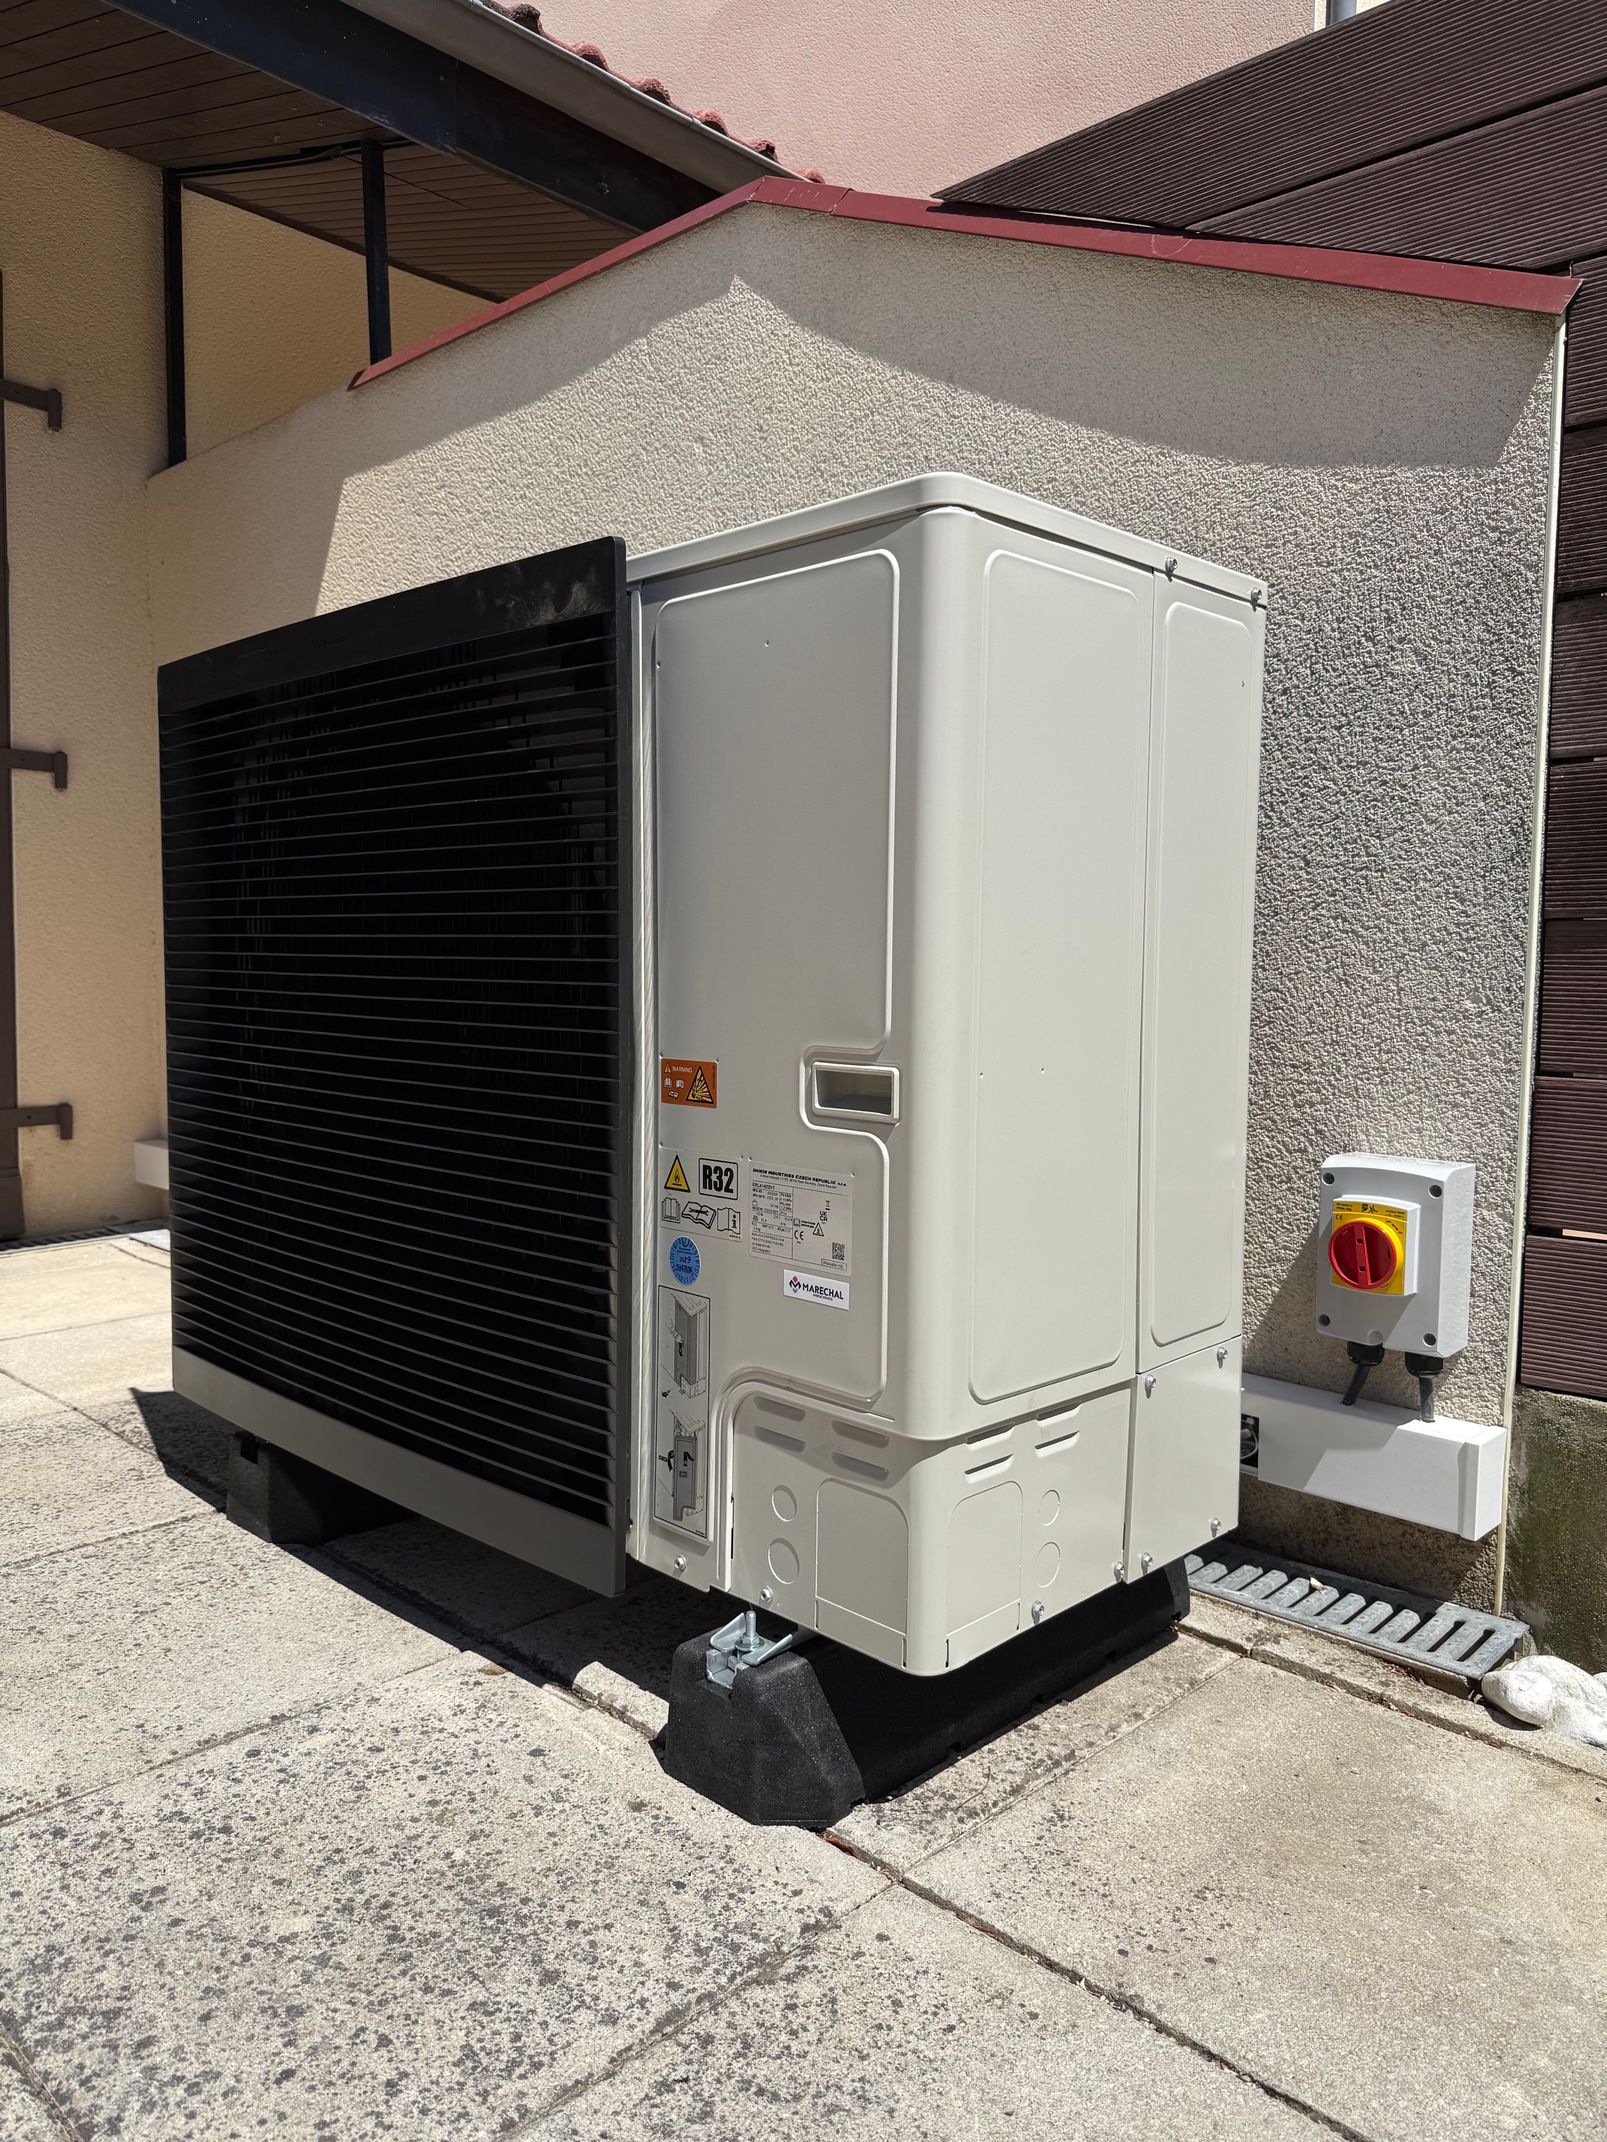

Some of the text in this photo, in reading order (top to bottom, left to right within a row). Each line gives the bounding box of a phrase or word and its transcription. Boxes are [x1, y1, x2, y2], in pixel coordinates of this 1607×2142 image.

[702, 1164, 735, 1194] R32
[768, 1170, 795, 1178] INDUSTRIES
[812, 1177, 837, 1185] REPUBLIC
[802, 1283, 844, 1300] MARECHAL
